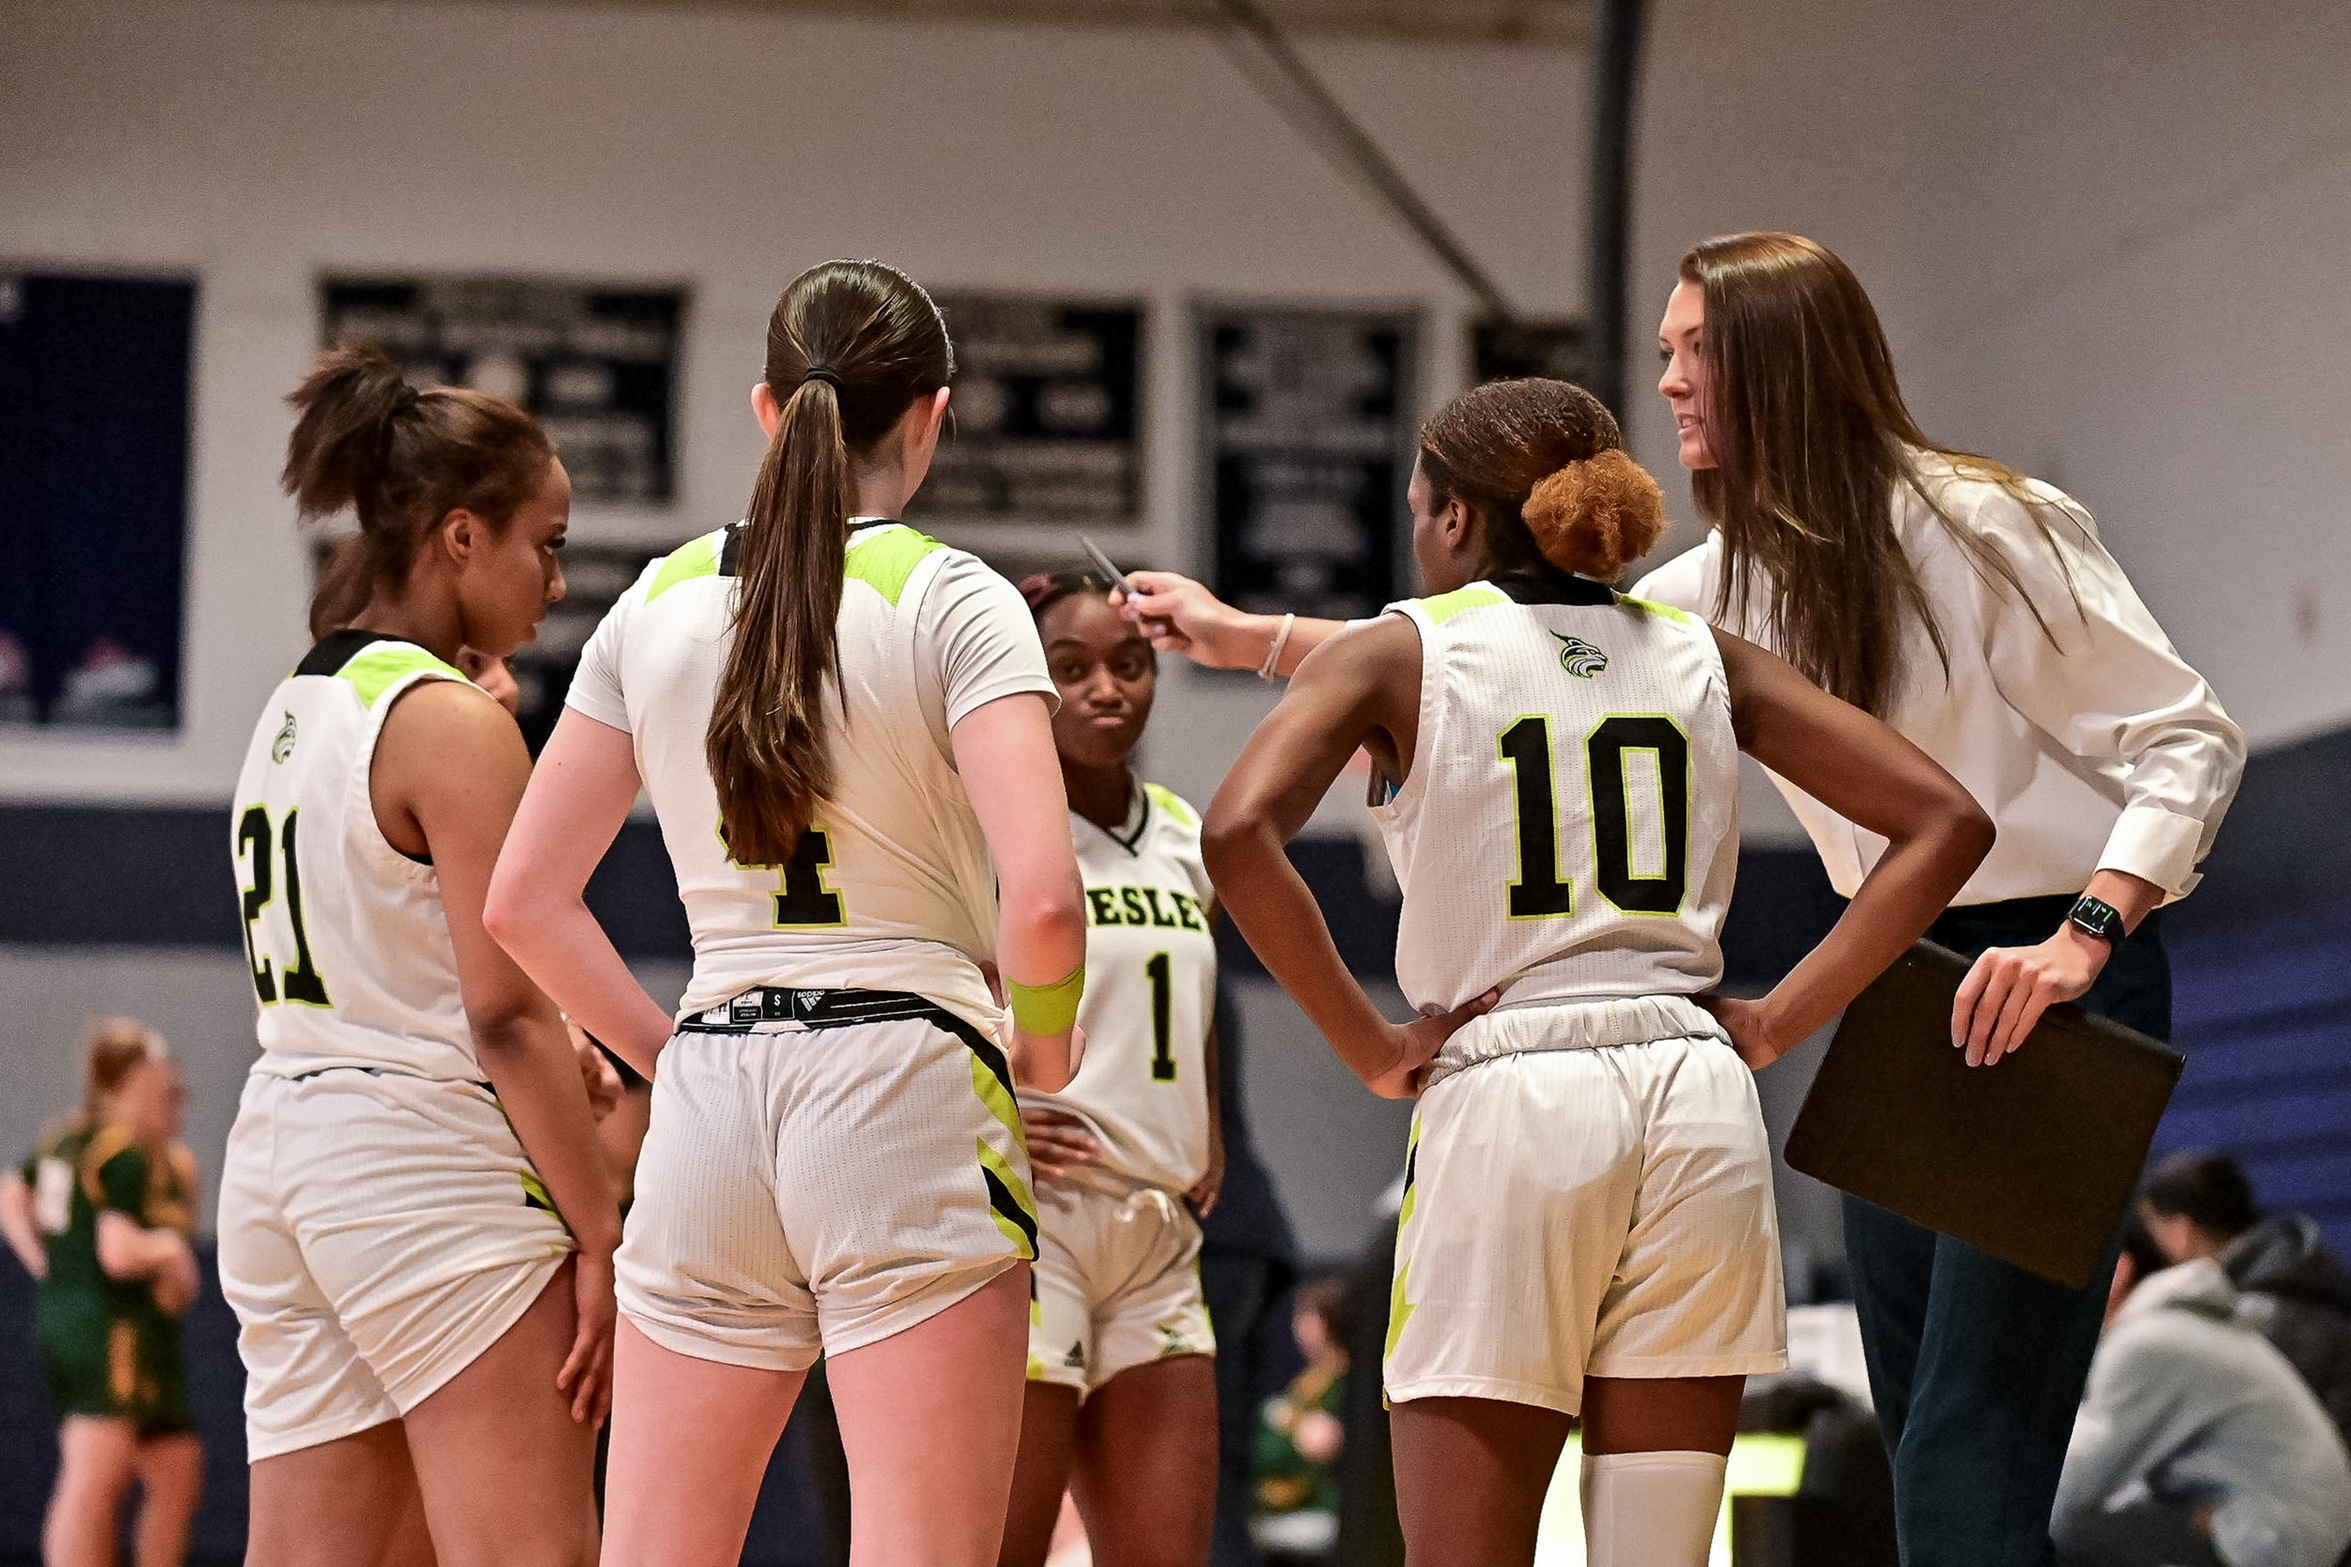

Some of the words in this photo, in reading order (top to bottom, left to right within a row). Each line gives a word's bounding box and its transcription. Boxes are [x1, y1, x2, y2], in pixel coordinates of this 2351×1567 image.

[238, 803, 334, 1009] 21
[1497, 713, 1691, 921] 10
[1145, 951, 1176, 1083] 1
